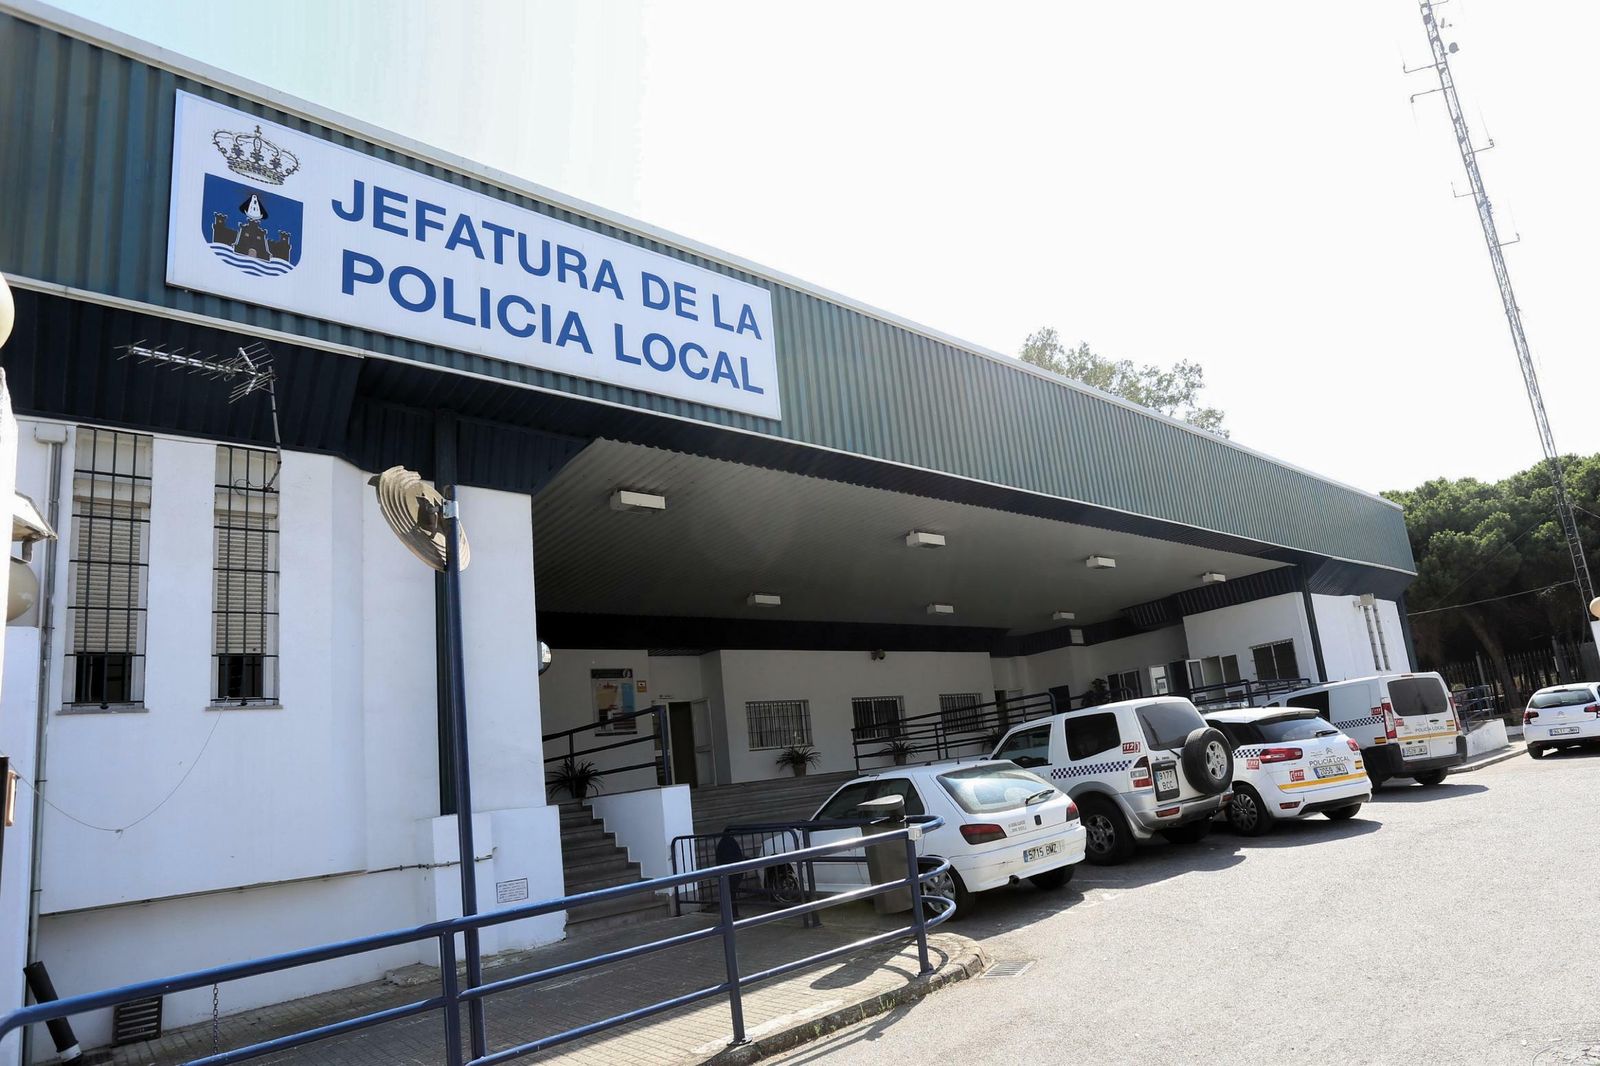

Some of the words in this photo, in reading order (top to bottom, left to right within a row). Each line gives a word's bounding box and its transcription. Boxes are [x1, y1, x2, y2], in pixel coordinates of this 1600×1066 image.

[331, 179, 625, 301] JEFATURA
[641, 271, 699, 322] DE
[712, 293, 762, 341] LA
[342, 248, 593, 354] POLICIA
[614, 322, 764, 395] LOCAL
[1333, 755, 1350, 764] LOCAL
[1159, 770, 1173, 780] 9177
[1027, 847, 1045, 860] 5715
[1045, 843, 1058, 855] BMZ
